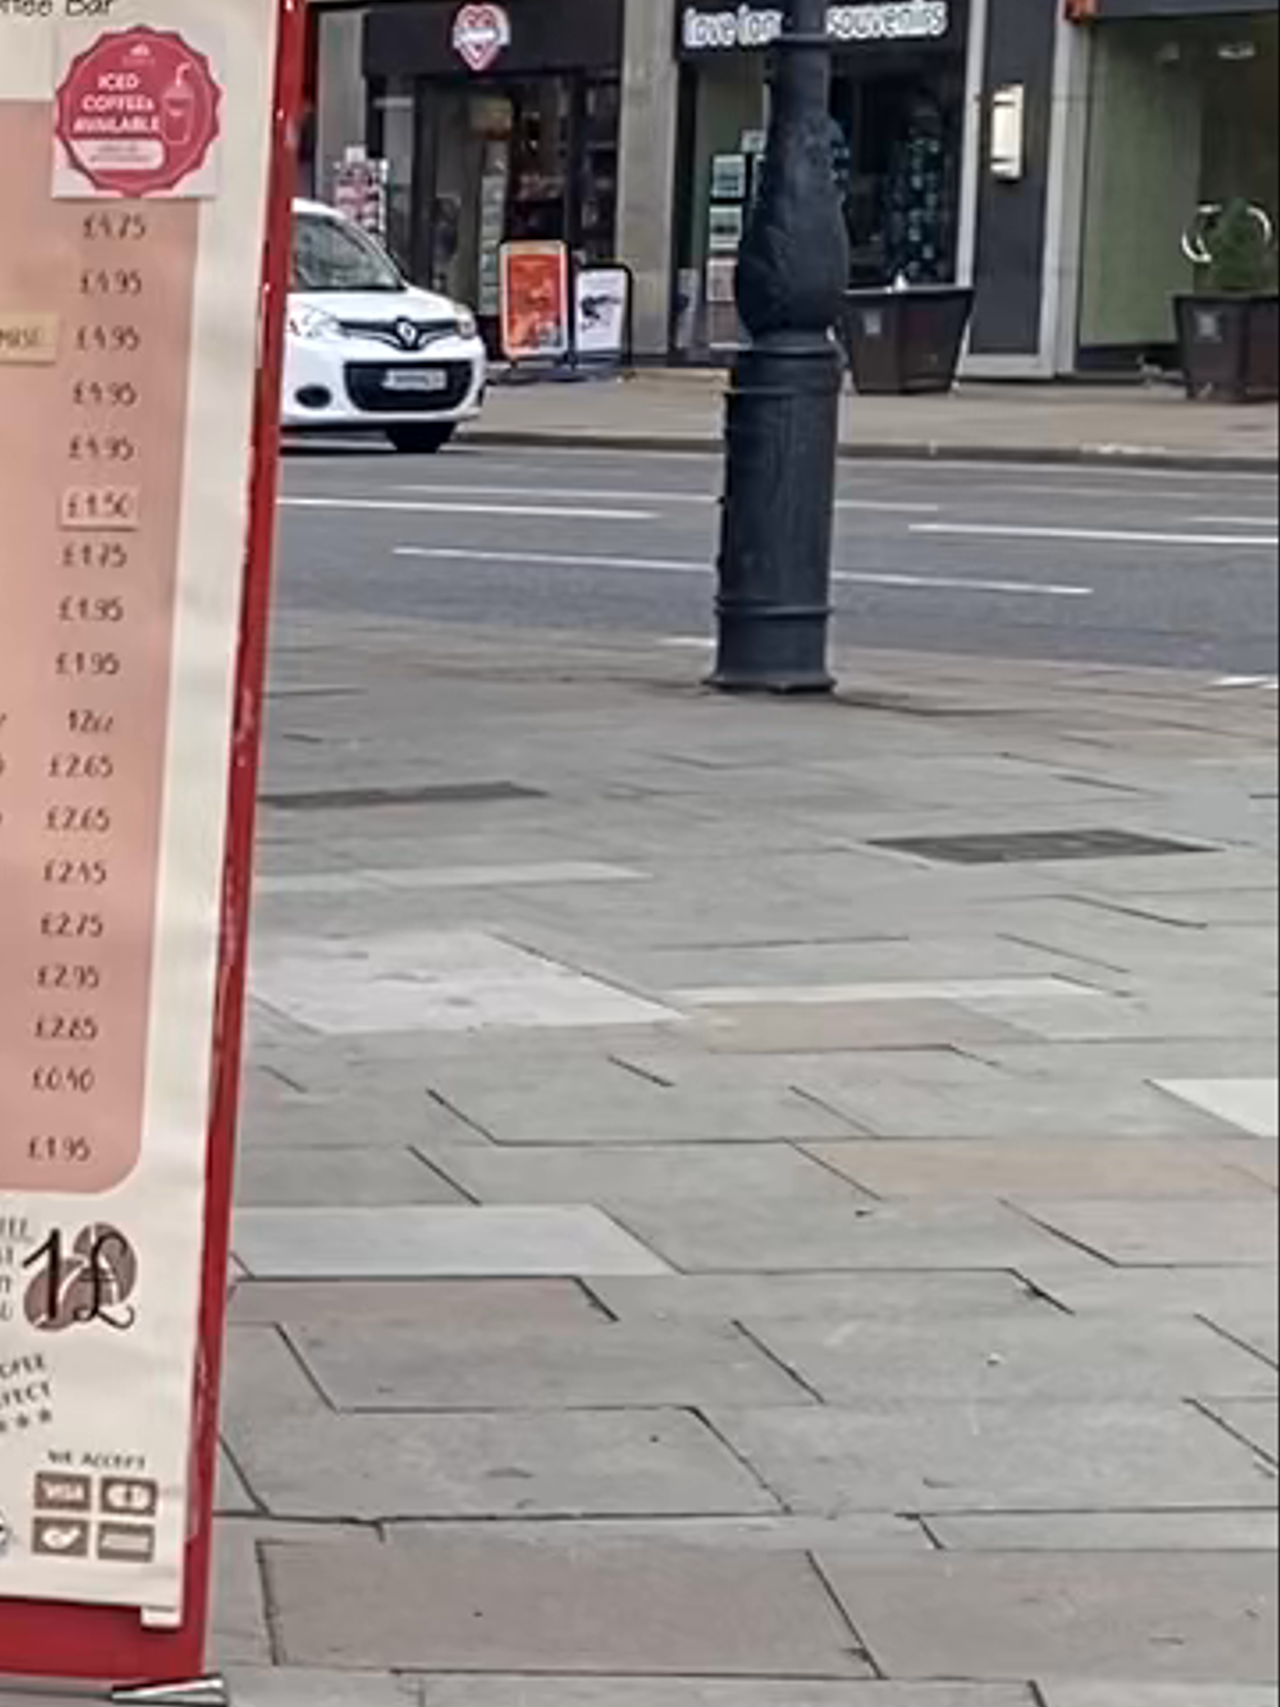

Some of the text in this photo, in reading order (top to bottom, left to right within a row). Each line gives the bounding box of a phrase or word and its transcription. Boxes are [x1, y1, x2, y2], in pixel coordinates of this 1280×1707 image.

[683, 6, 738, 49] love
[98, 73, 139, 91] ICED
[73, 116, 160, 132] AVAILABLE
[47, 1449, 146, 1470] WE ACCEPT
